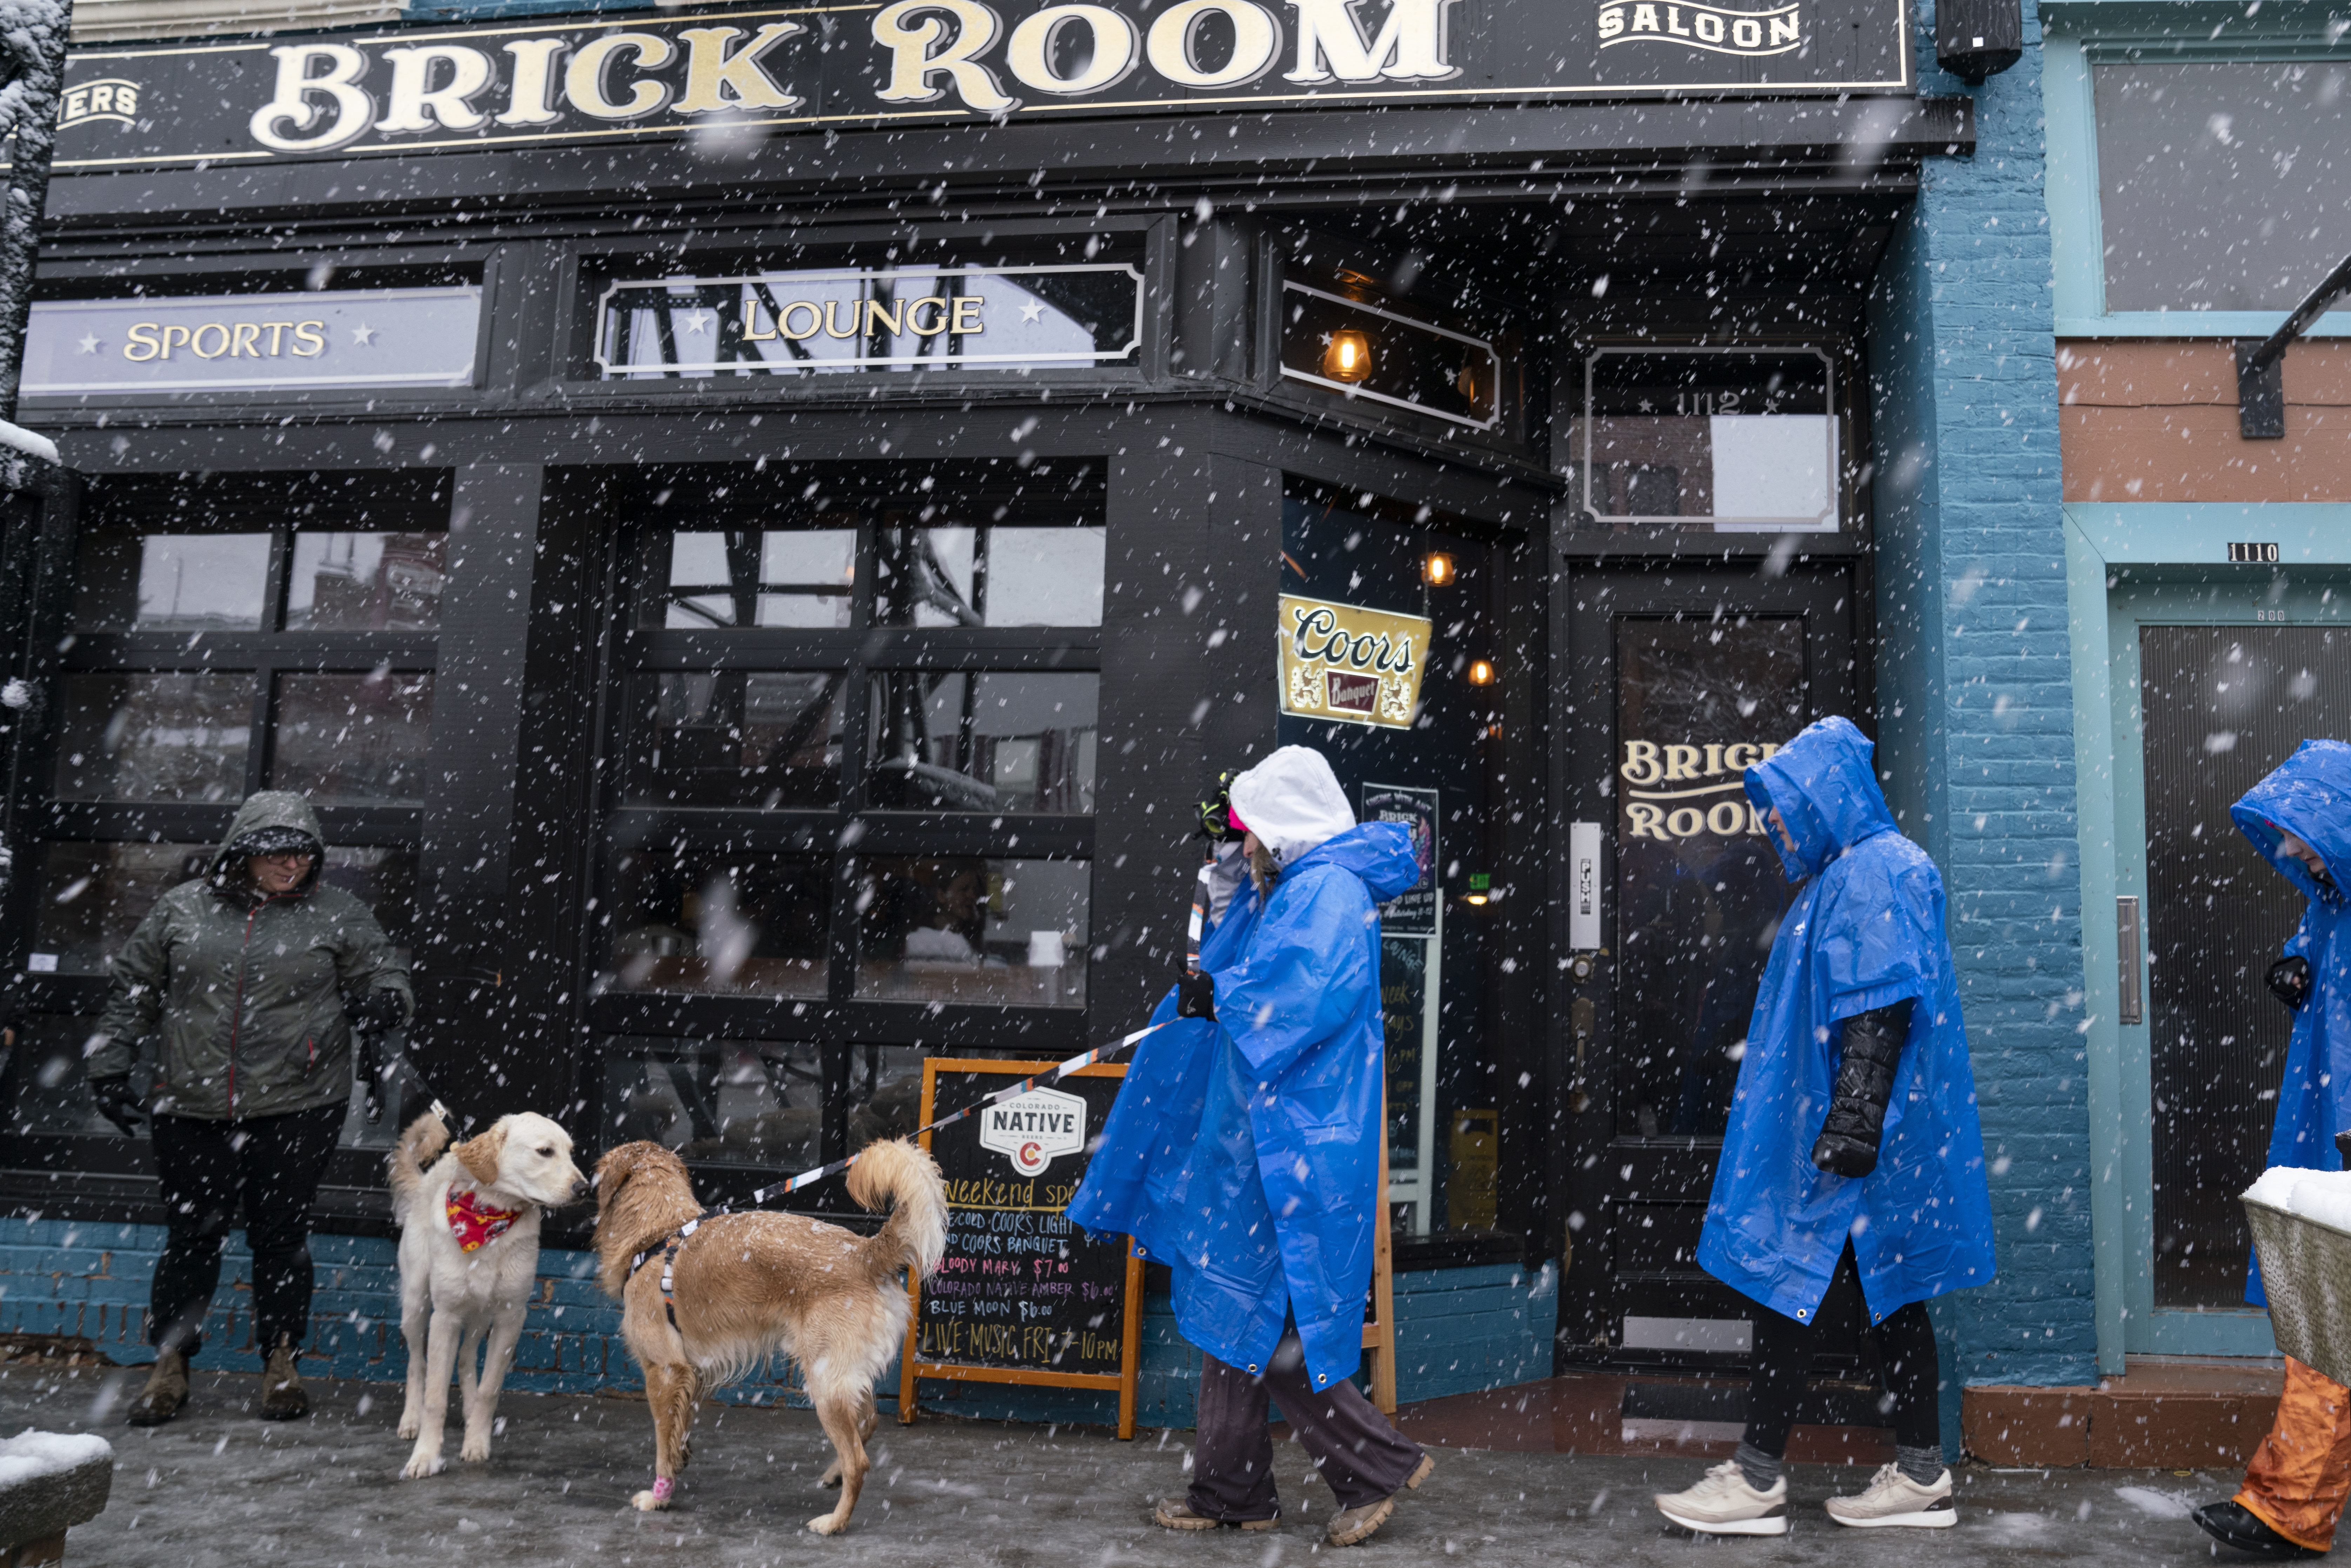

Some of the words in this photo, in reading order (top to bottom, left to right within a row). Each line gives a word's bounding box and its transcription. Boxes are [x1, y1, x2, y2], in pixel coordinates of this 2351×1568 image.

[1599, 4, 1800, 47] SALOON
[250, 22, 804, 152] BRICK
[872, 0, 1463, 112] ROOM
[57, 86, 137, 122] ERS
[744, 296, 984, 341] LOUNGE
[123, 320, 327, 362] SPORTS
[1678, 393, 1741, 415] 1112
[2230, 543, 2277, 562] 1110
[1293, 606, 1415, 675] Coors
[1332, 676, 1374, 706] Banquet
[1379, 809, 1418, 823] BRICK
[1581, 863, 1590, 902] PUSH
[993, 1111, 1074, 1133] NATIVE
[991, 1211, 1033, 1236] COORS
[945, 1232, 958, 1245] ND
[962, 1233, 1001, 1255] COORS
[1007, 1235, 1069, 1255] BANQUET
[983, 1259, 1019, 1276] MARY
[1034, 1259, 1068, 1282] $7.00
[930, 1279, 981, 1299] COLORADO
[987, 1281, 1027, 1297] NATIVE
[1032, 1281, 1074, 1298] AMBER
[1081, 1281, 1113, 1301] $6.00
[930, 1300, 966, 1315] BLUE
[973, 1299, 1011, 1316] MOON
[1019, 1300, 1052, 1322] $6.00
[923, 1320, 963, 1353] LIVE
[970, 1323, 1016, 1358] MUSIC
[1023, 1326, 1052, 1363] FRI
